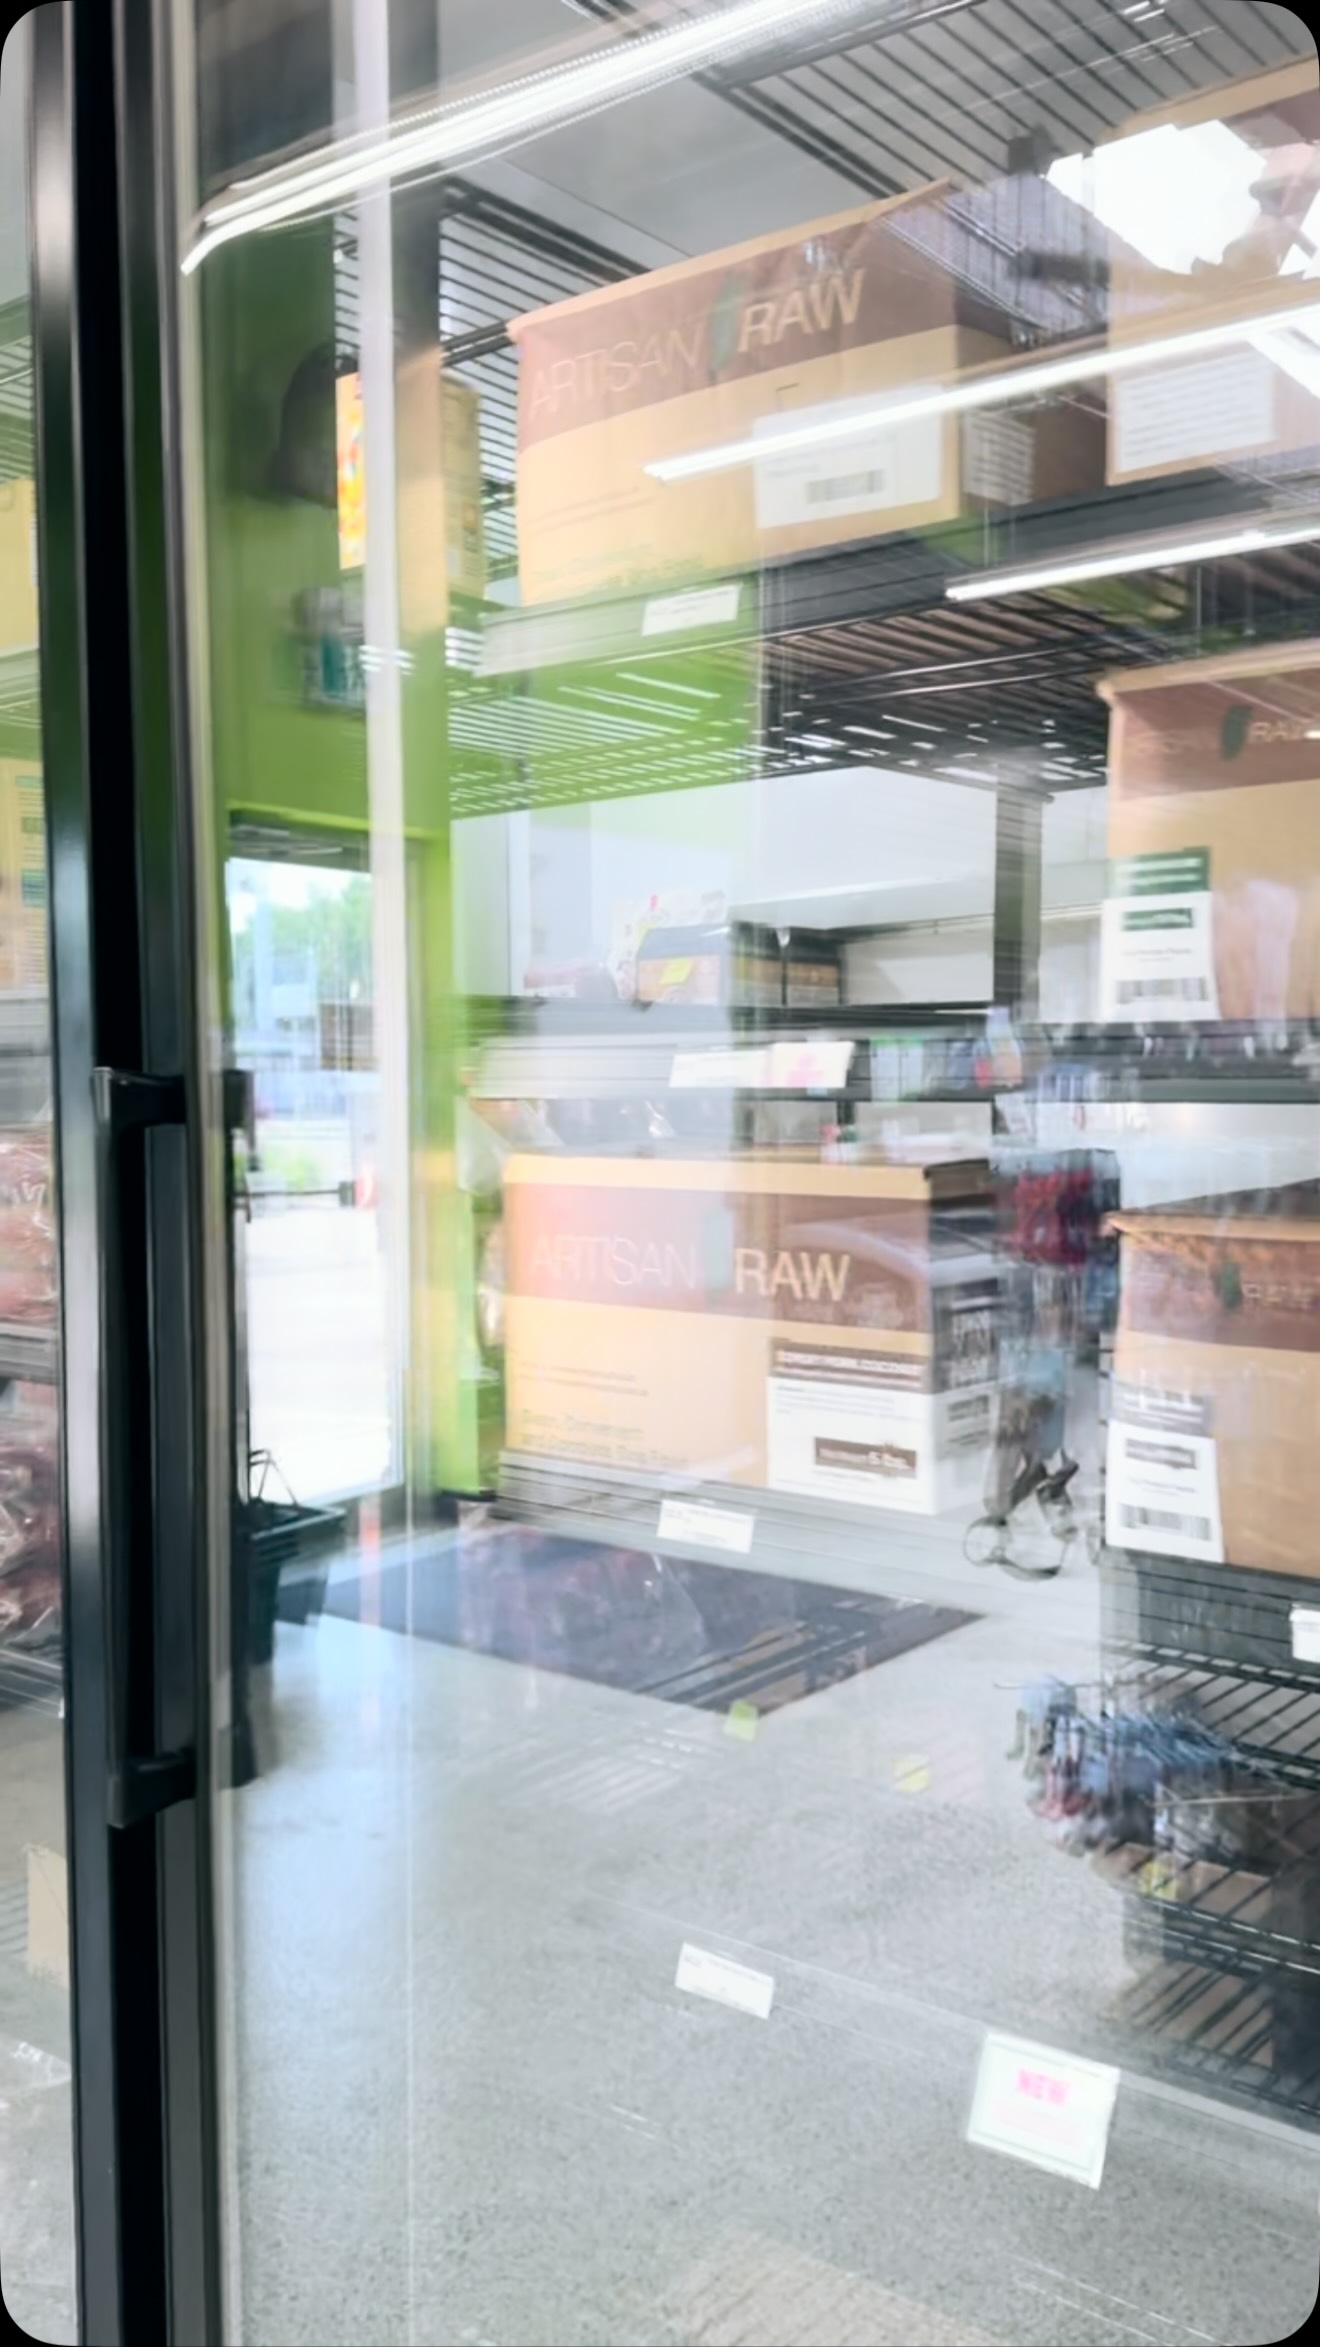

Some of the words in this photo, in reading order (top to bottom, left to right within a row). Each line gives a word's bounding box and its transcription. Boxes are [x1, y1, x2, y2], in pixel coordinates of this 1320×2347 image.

[530, 325, 704, 421] ARTISAN
[738, 267, 866, 354] RAW
[529, 1235, 698, 1289] ARTISAN
[733, 1247, 850, 1302] RAW
